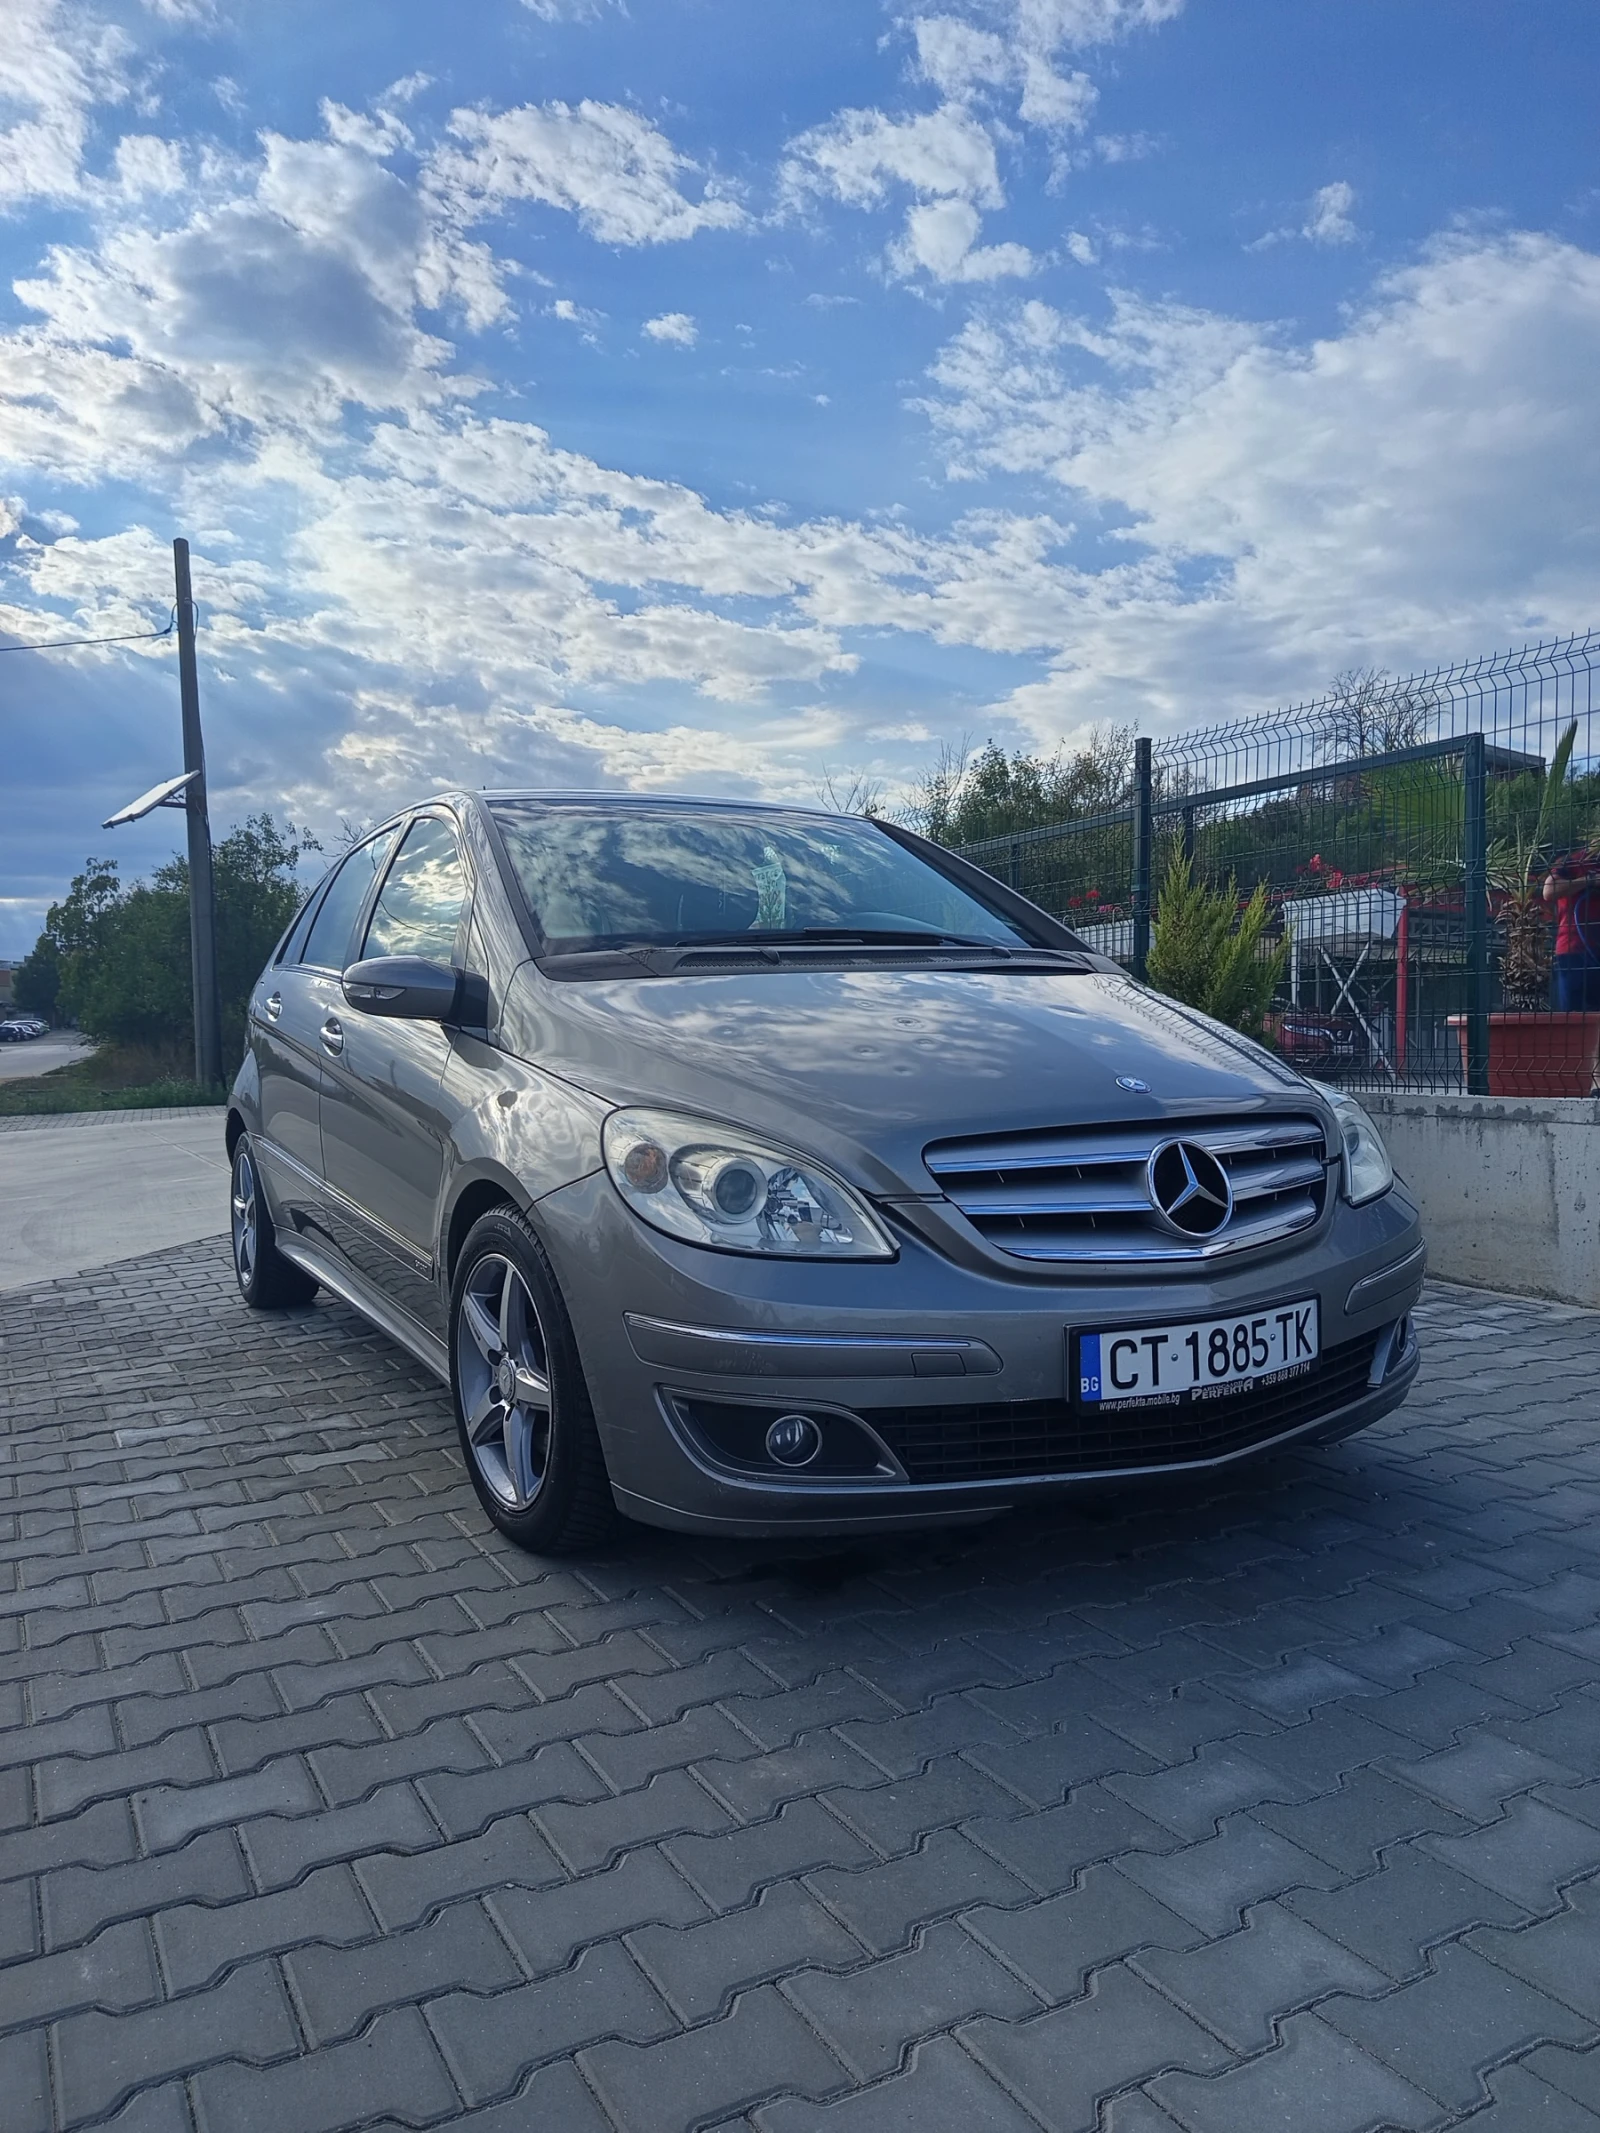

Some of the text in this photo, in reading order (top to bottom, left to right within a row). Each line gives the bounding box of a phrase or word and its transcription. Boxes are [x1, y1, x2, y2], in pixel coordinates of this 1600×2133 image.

[1109, 1307, 1313, 1390] CT 1885 TK
[1080, 1376, 1100, 1394] BG
[1261, 1373, 1276, 1385] +359
[1098, 1393, 1181, 1412] www.perfekta.mobile.bg
